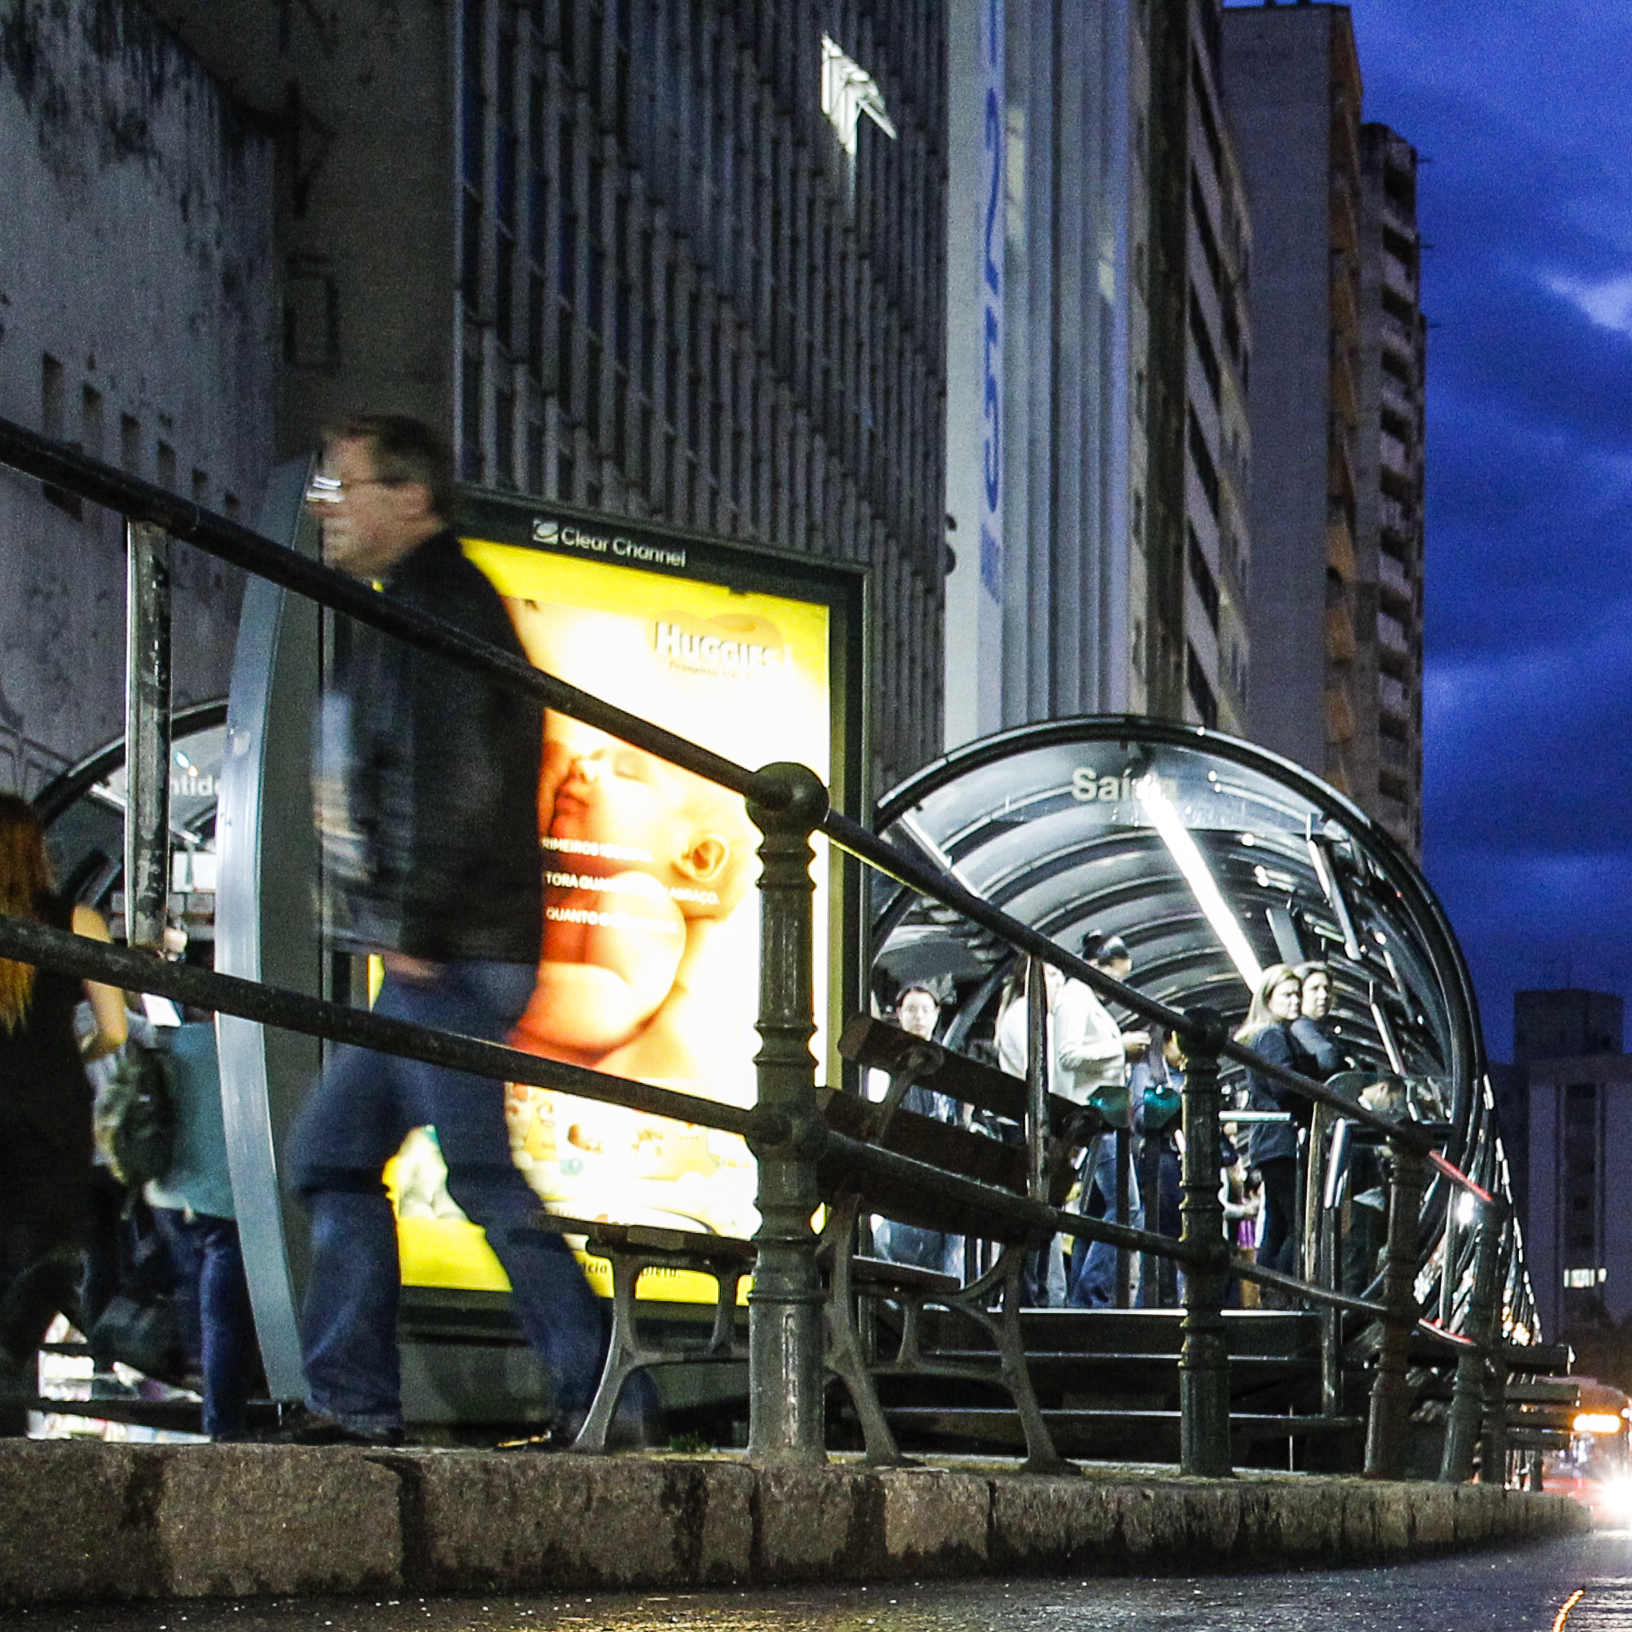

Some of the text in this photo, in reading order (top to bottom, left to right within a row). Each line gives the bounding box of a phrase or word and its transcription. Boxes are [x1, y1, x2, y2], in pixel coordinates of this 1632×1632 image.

[560, 526, 687, 568] Clear Channel
[655, 620, 783, 671] HUGGIES
